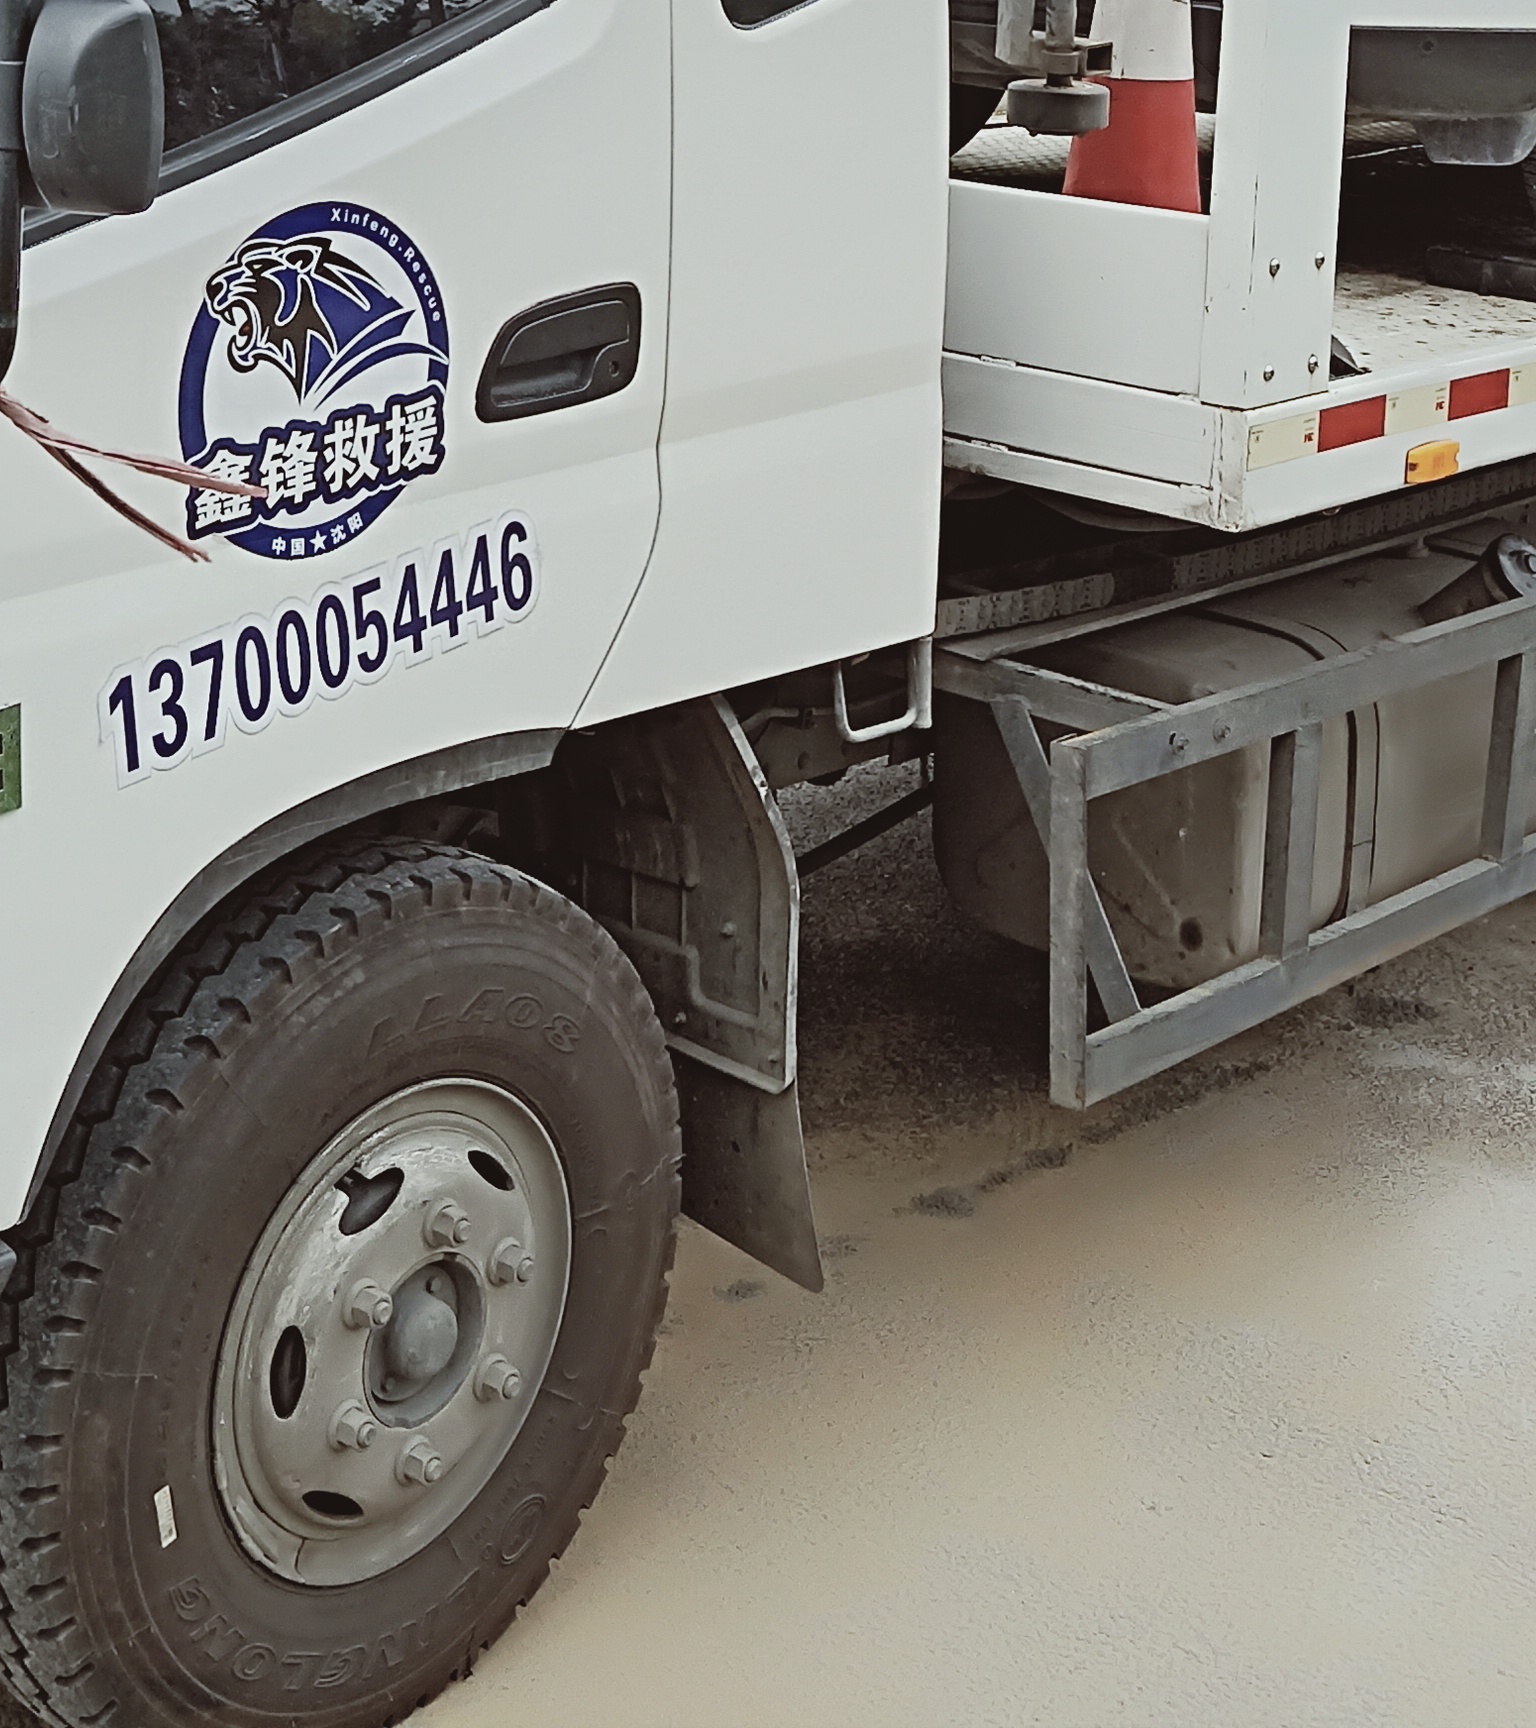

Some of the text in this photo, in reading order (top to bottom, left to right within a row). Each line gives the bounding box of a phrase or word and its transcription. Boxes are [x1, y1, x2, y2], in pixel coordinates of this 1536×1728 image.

[195, 395, 439, 531] 鑫锋救援
[271, 511, 364, 558] 中国 沈阳
[108, 520, 533, 774] 13700054446
